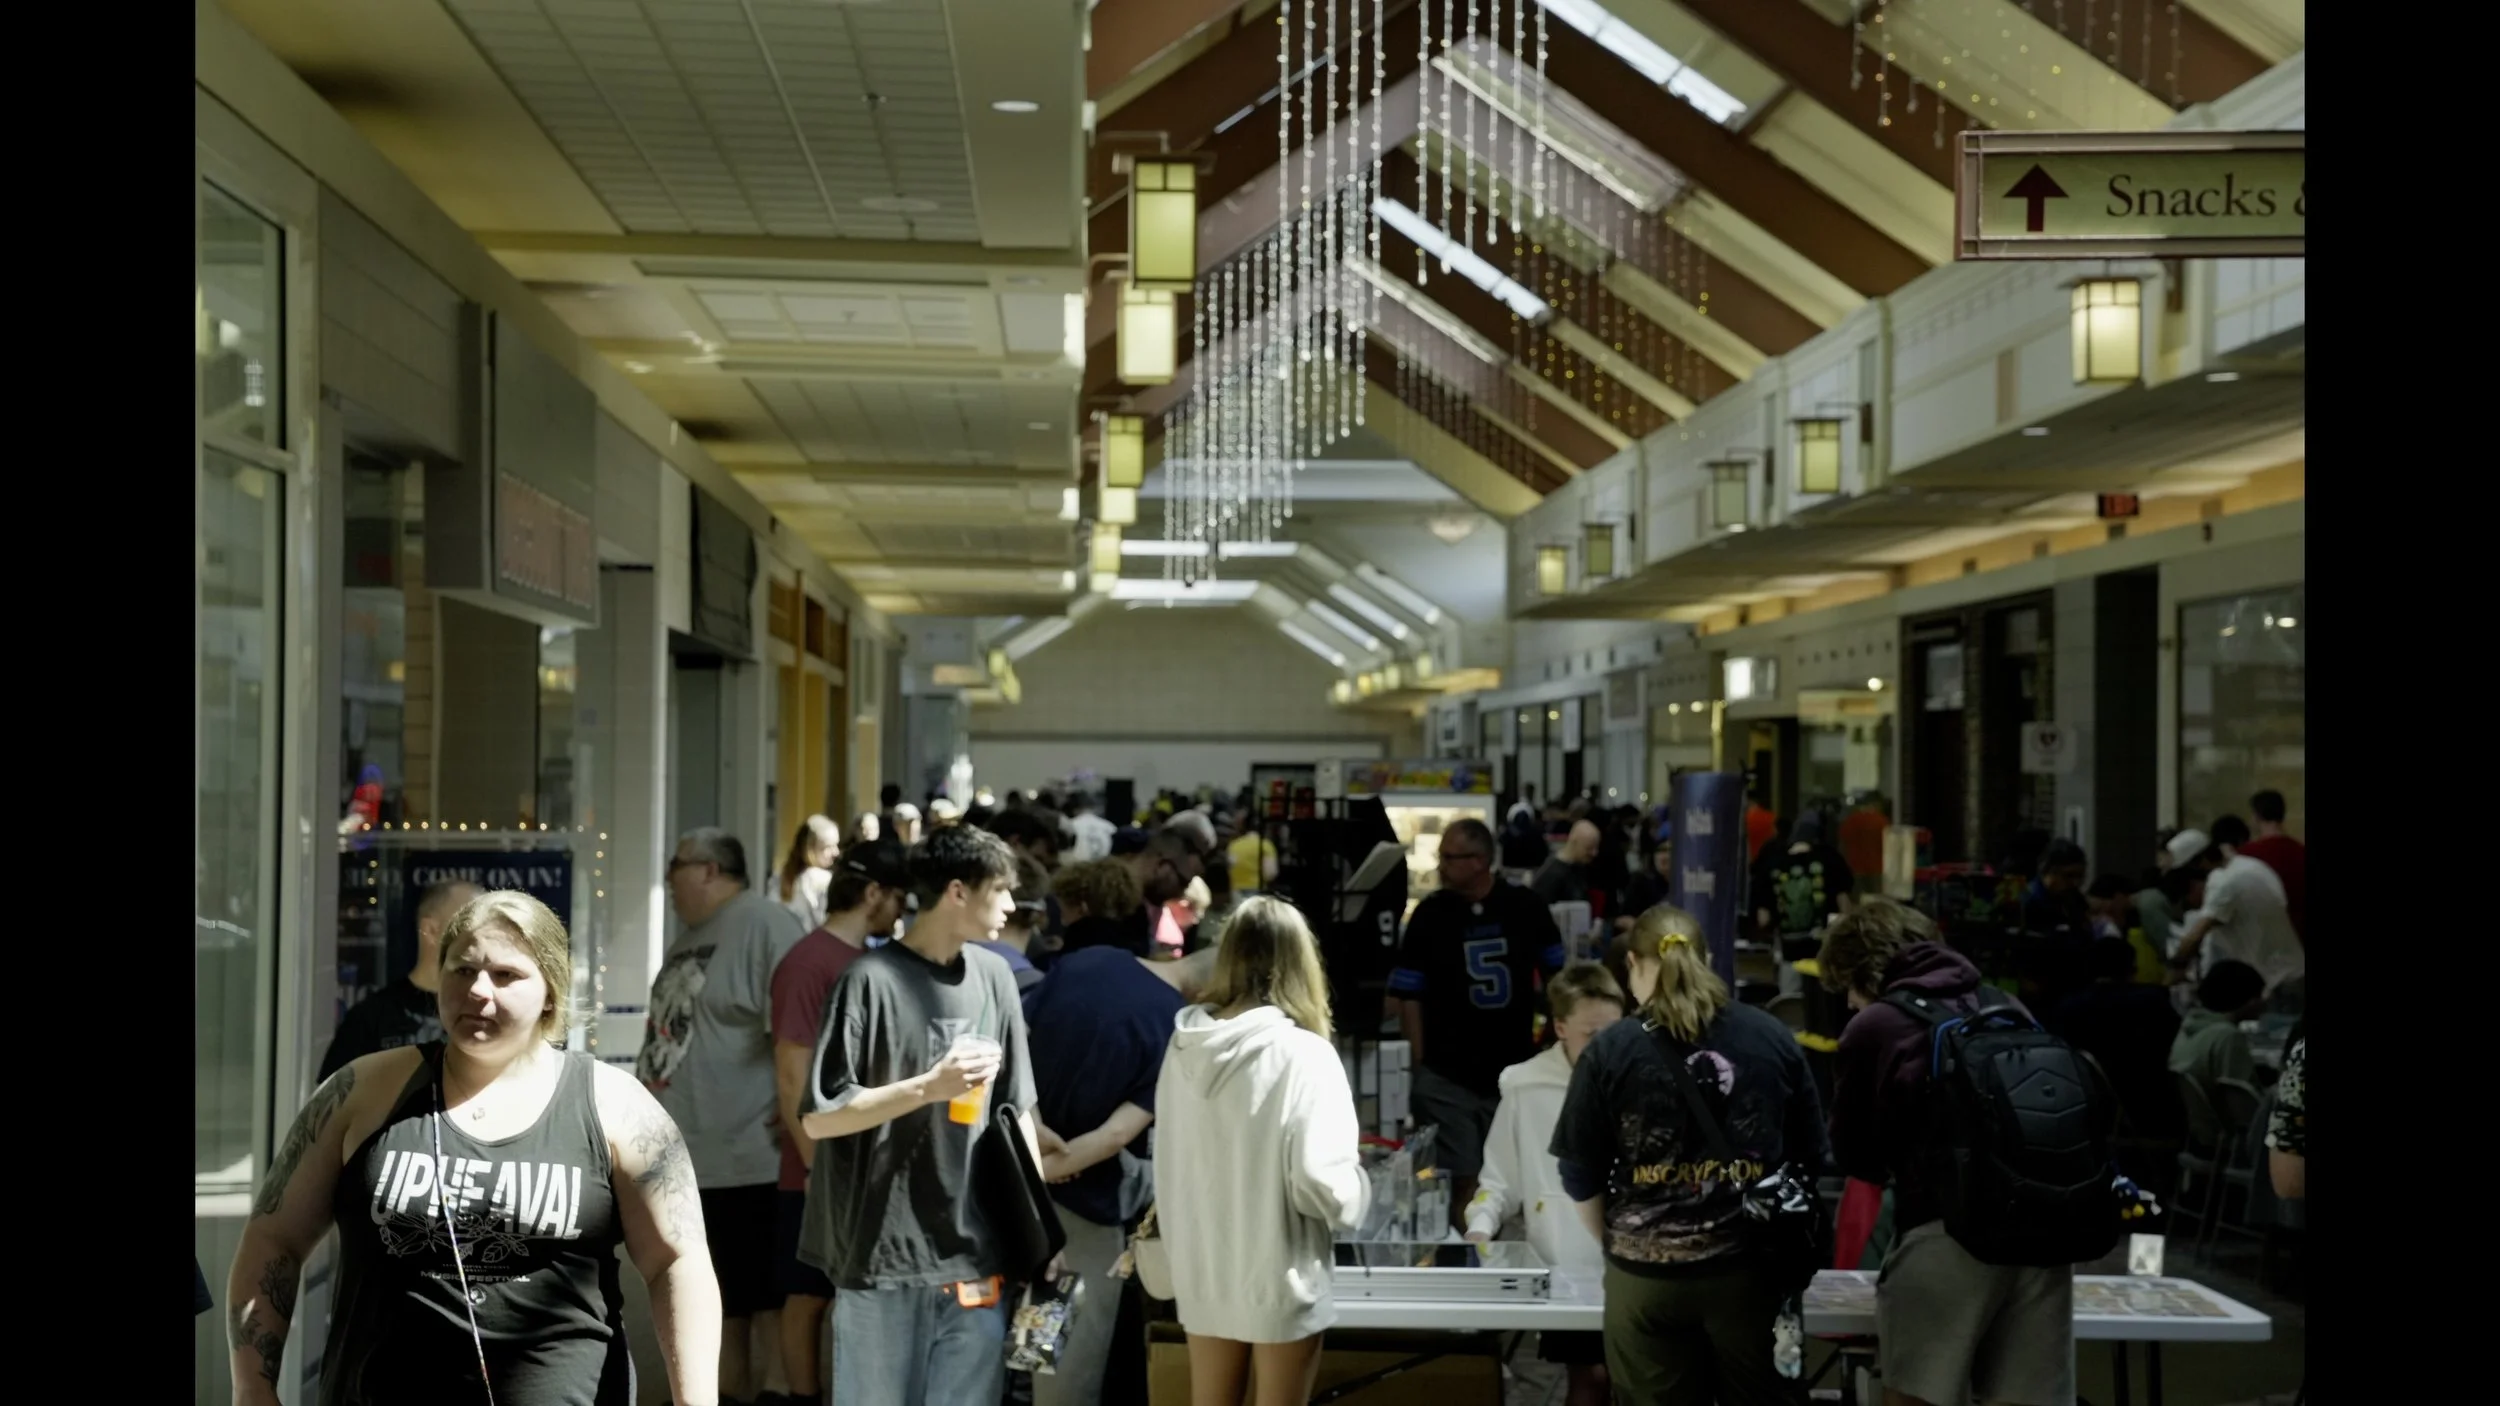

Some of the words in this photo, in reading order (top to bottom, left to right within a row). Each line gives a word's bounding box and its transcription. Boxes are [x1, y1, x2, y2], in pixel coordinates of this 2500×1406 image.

[2106, 172, 2277, 217] Snacks
[412, 866, 483, 888] COME
[487, 866, 524, 888] ON
[528, 865, 563, 888] IN!
[1463, 936, 1514, 1010] 5
[371, 1150, 583, 1240] UPHEAVAL
[420, 1270, 462, 1281] MUSIC
